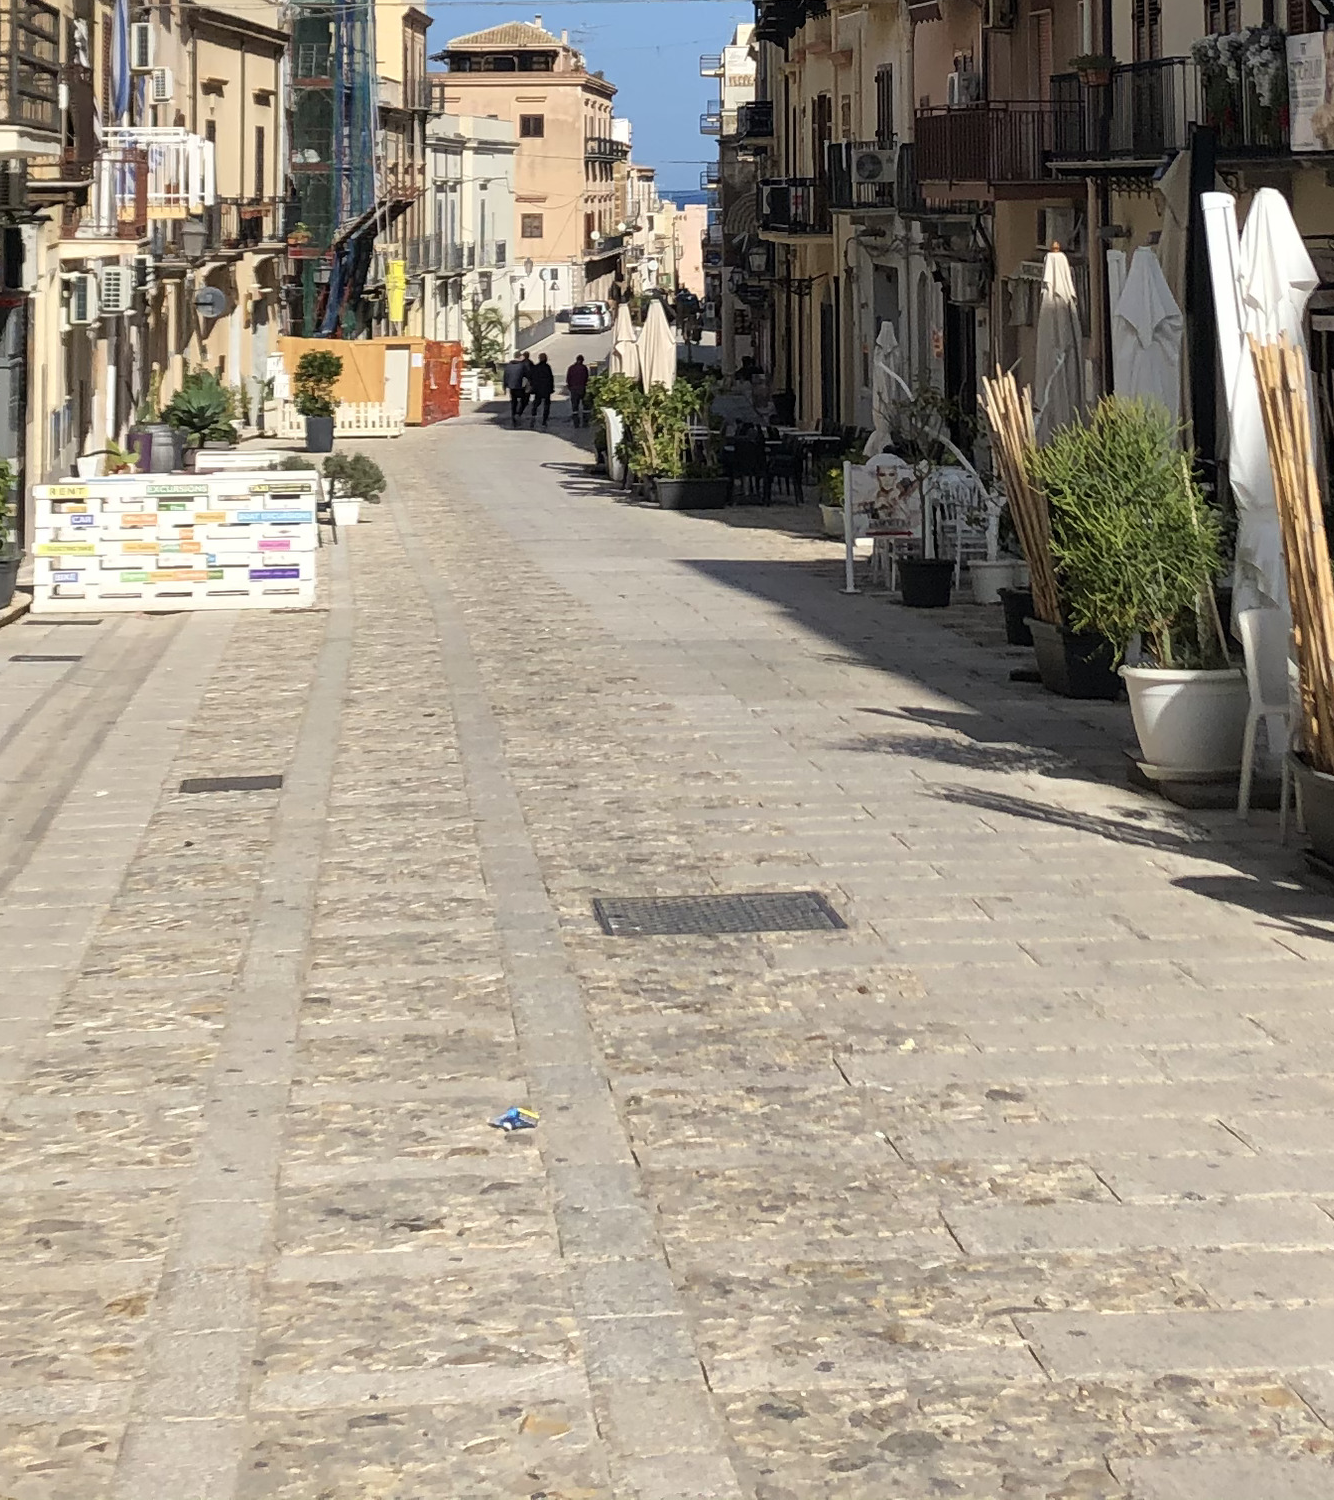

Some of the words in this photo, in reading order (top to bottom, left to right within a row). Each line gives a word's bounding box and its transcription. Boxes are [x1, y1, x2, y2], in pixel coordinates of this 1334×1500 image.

[49, 487, 86, 496] RENT
[147, 485, 207, 494] EXCURSIONS
[72, 515, 92, 524] CAR
[54, 573, 77, 582] BIKE
